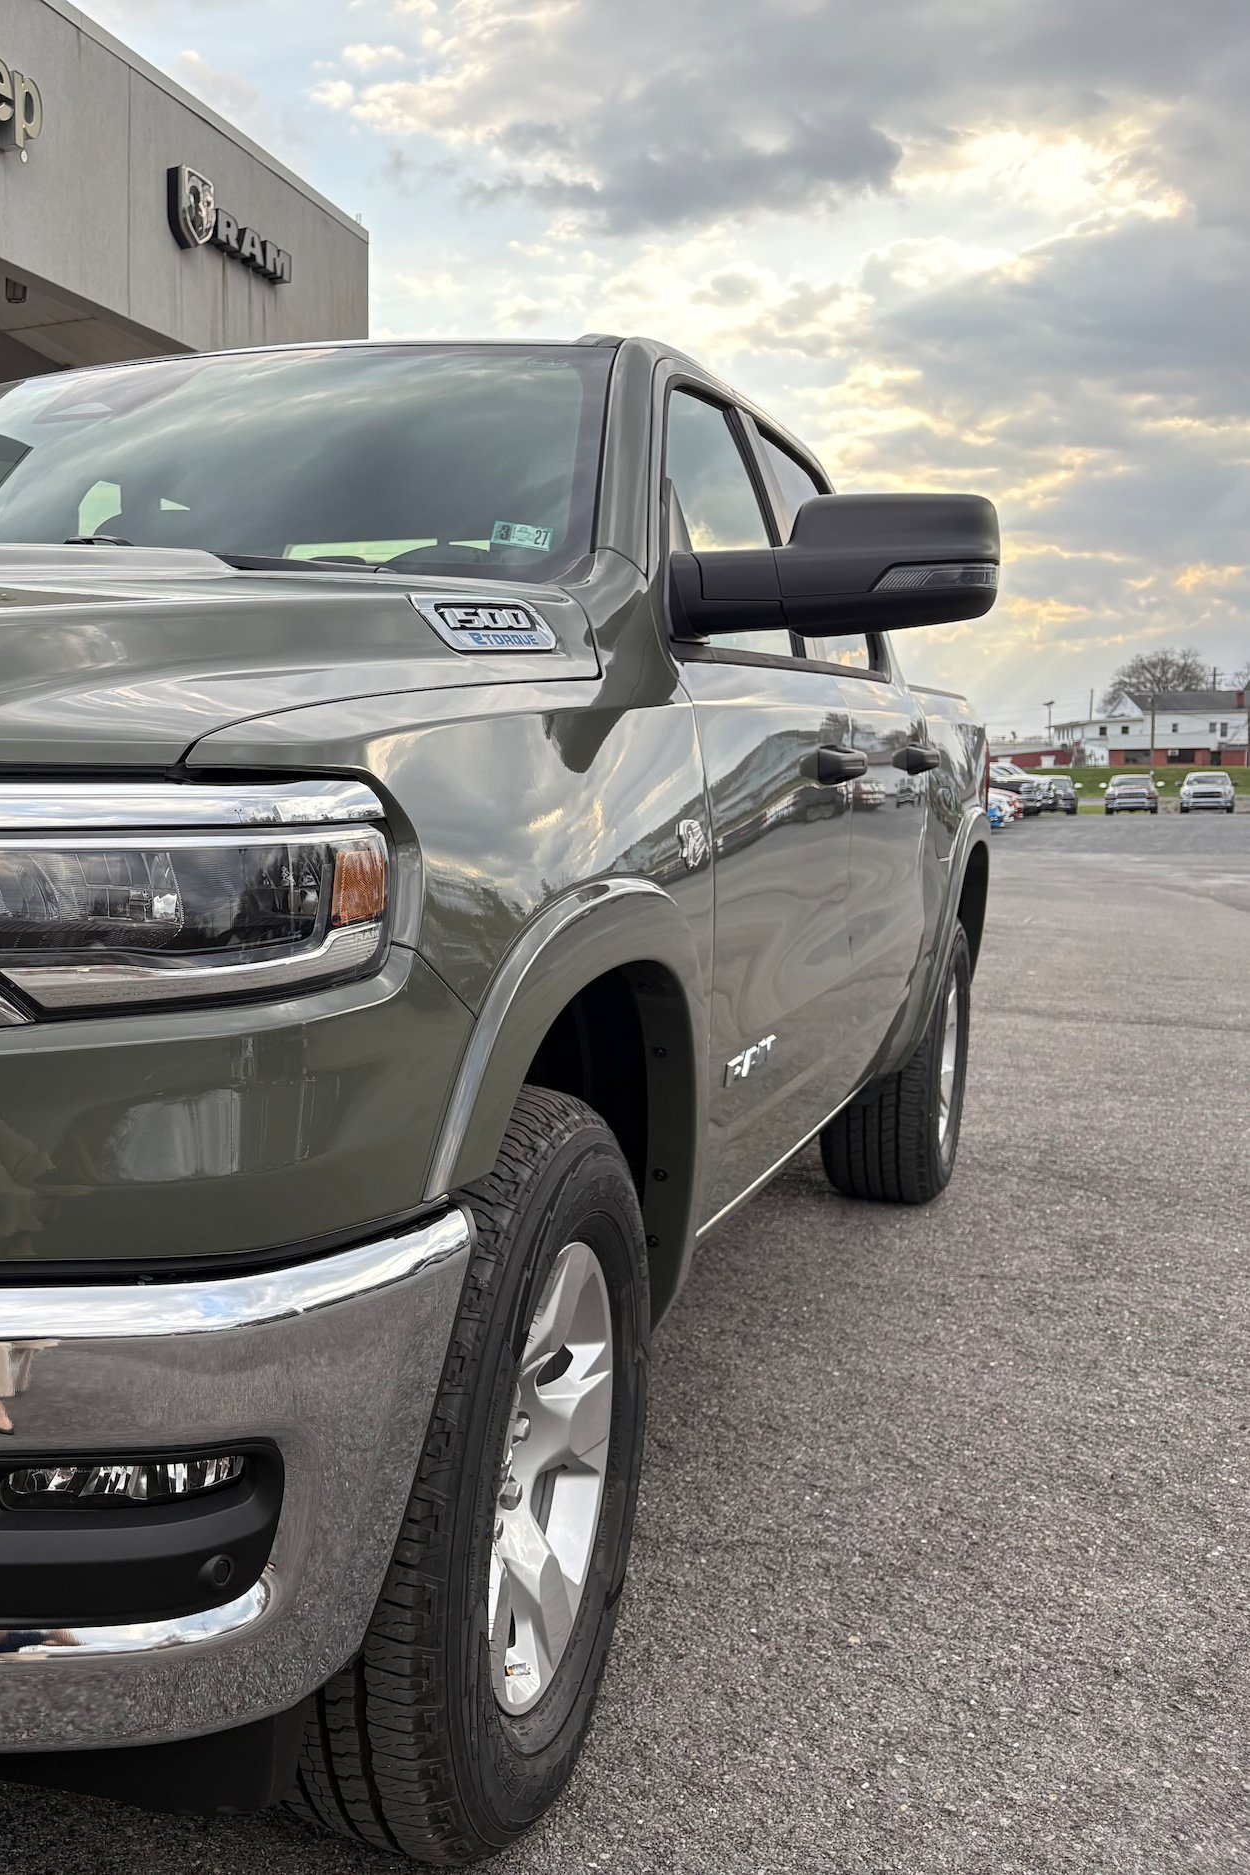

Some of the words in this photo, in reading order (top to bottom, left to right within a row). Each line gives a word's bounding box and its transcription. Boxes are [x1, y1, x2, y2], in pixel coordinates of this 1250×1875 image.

[209, 208, 293, 284] RAM
[533, 529, 549, 546] 27
[437, 606, 531, 630] 1500
